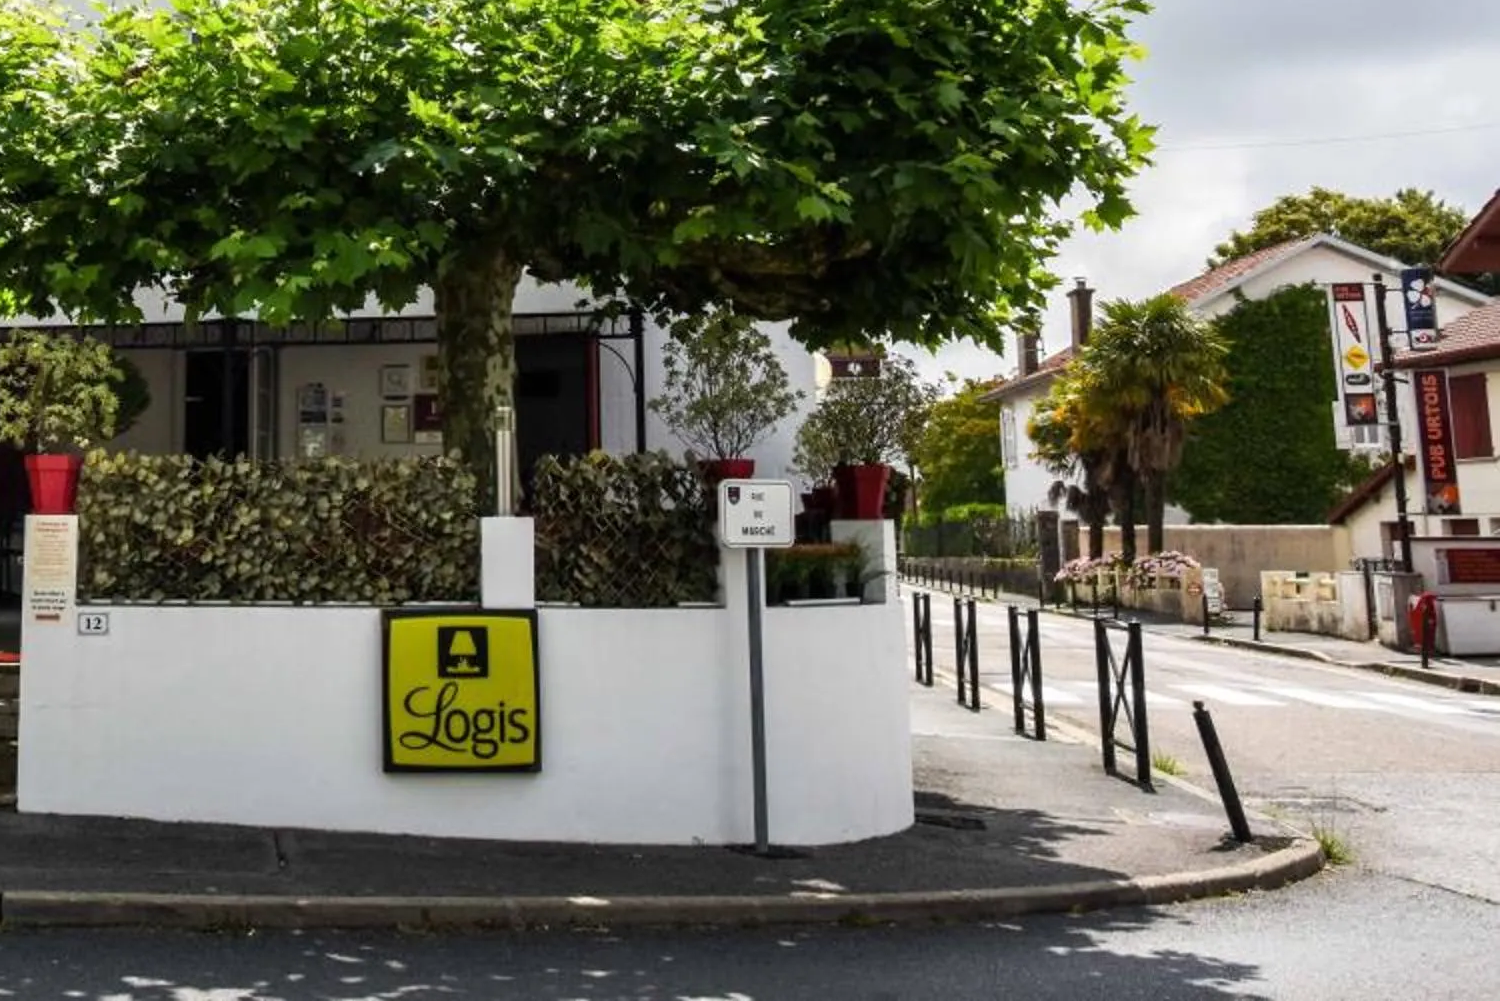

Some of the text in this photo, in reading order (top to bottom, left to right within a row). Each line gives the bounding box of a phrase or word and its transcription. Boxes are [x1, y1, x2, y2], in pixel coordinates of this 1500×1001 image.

[1422, 374, 1447, 479] PUB URTOIS
[85, 617, 102, 630] 12
[399, 681, 530, 760] Logis
